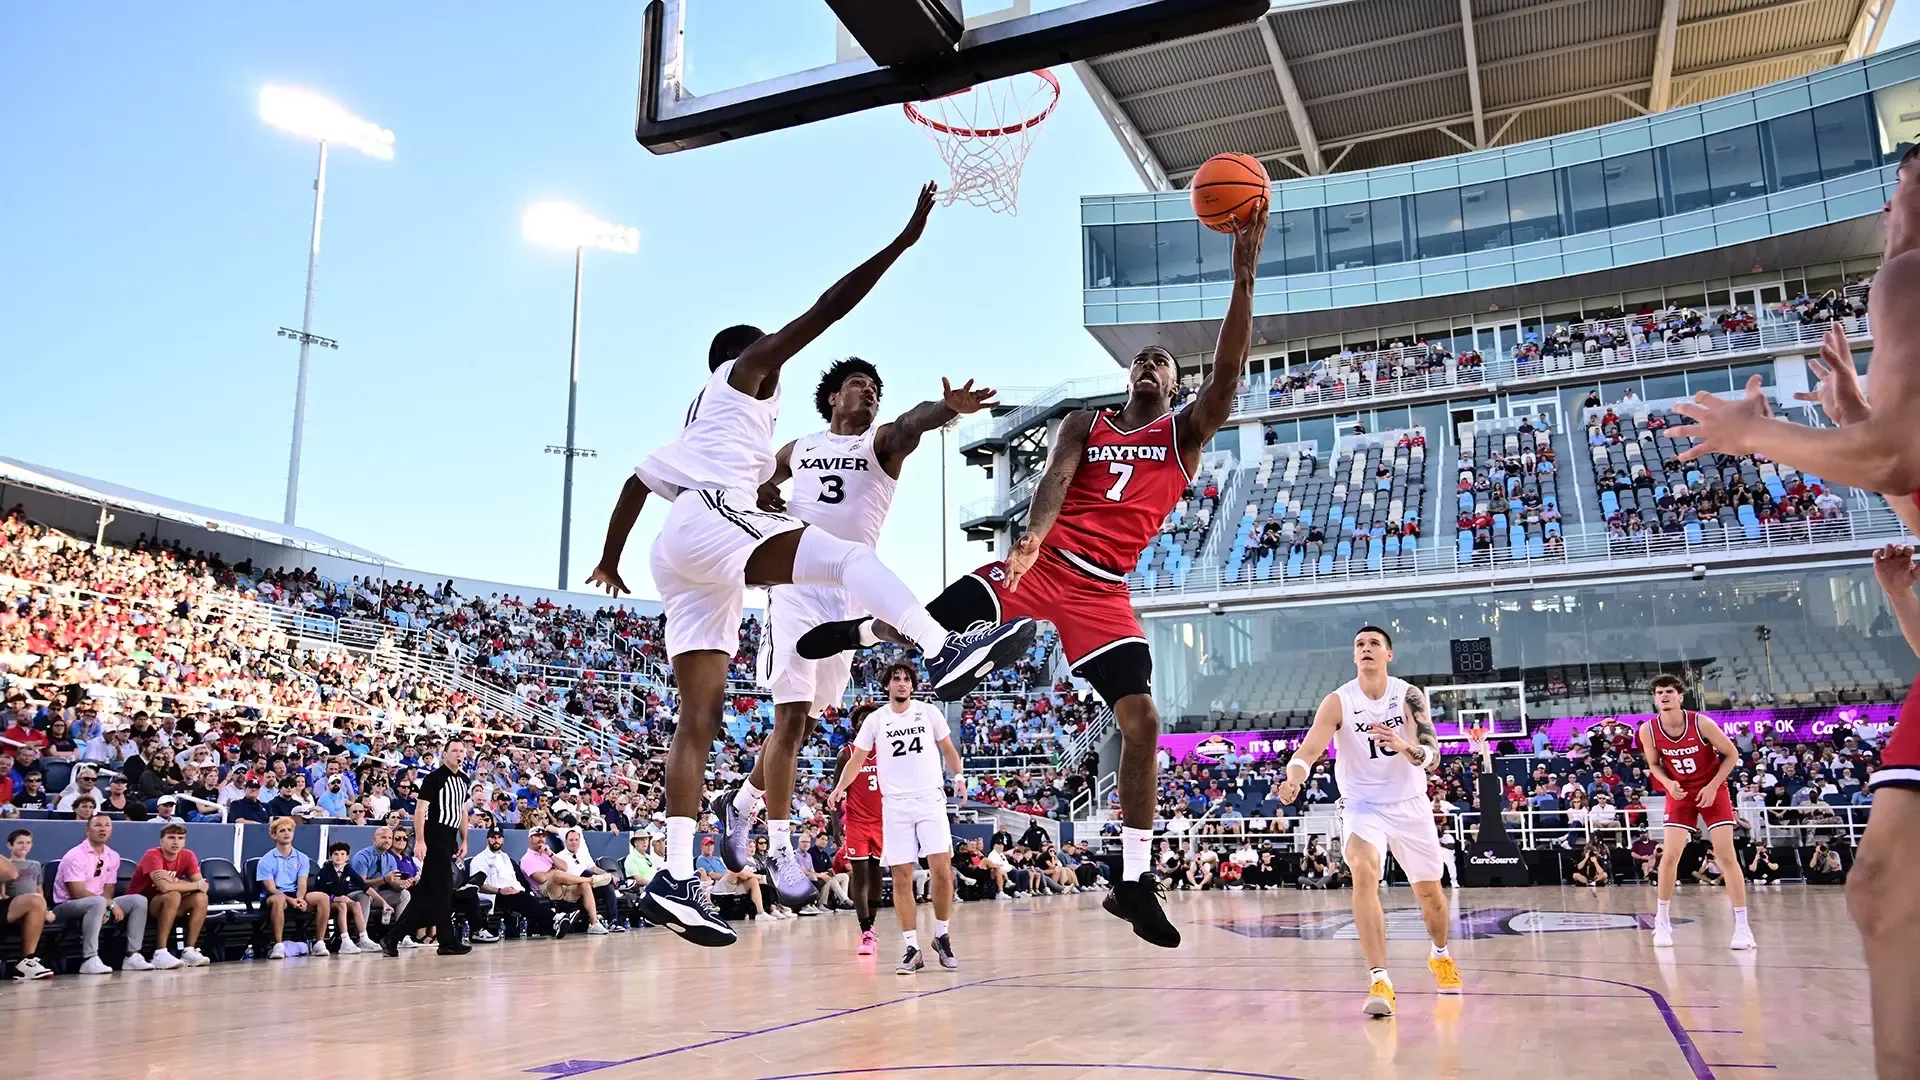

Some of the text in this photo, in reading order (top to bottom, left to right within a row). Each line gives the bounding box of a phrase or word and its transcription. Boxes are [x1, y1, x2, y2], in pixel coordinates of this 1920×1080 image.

[1087, 445, 1167, 462] DAYTON
[797, 457, 869, 471] XAVIER
[1105, 461, 1134, 502] 7
[817, 475, 846, 504] 3
[886, 726, 926, 738] XAVIER
[1775, 719, 1795, 733] OK
[891, 737, 924, 757] 24
[1661, 745, 1699, 756] DAYTON
[1670, 757, 1697, 774] 29
[1470, 856, 1519, 864] CareSource
